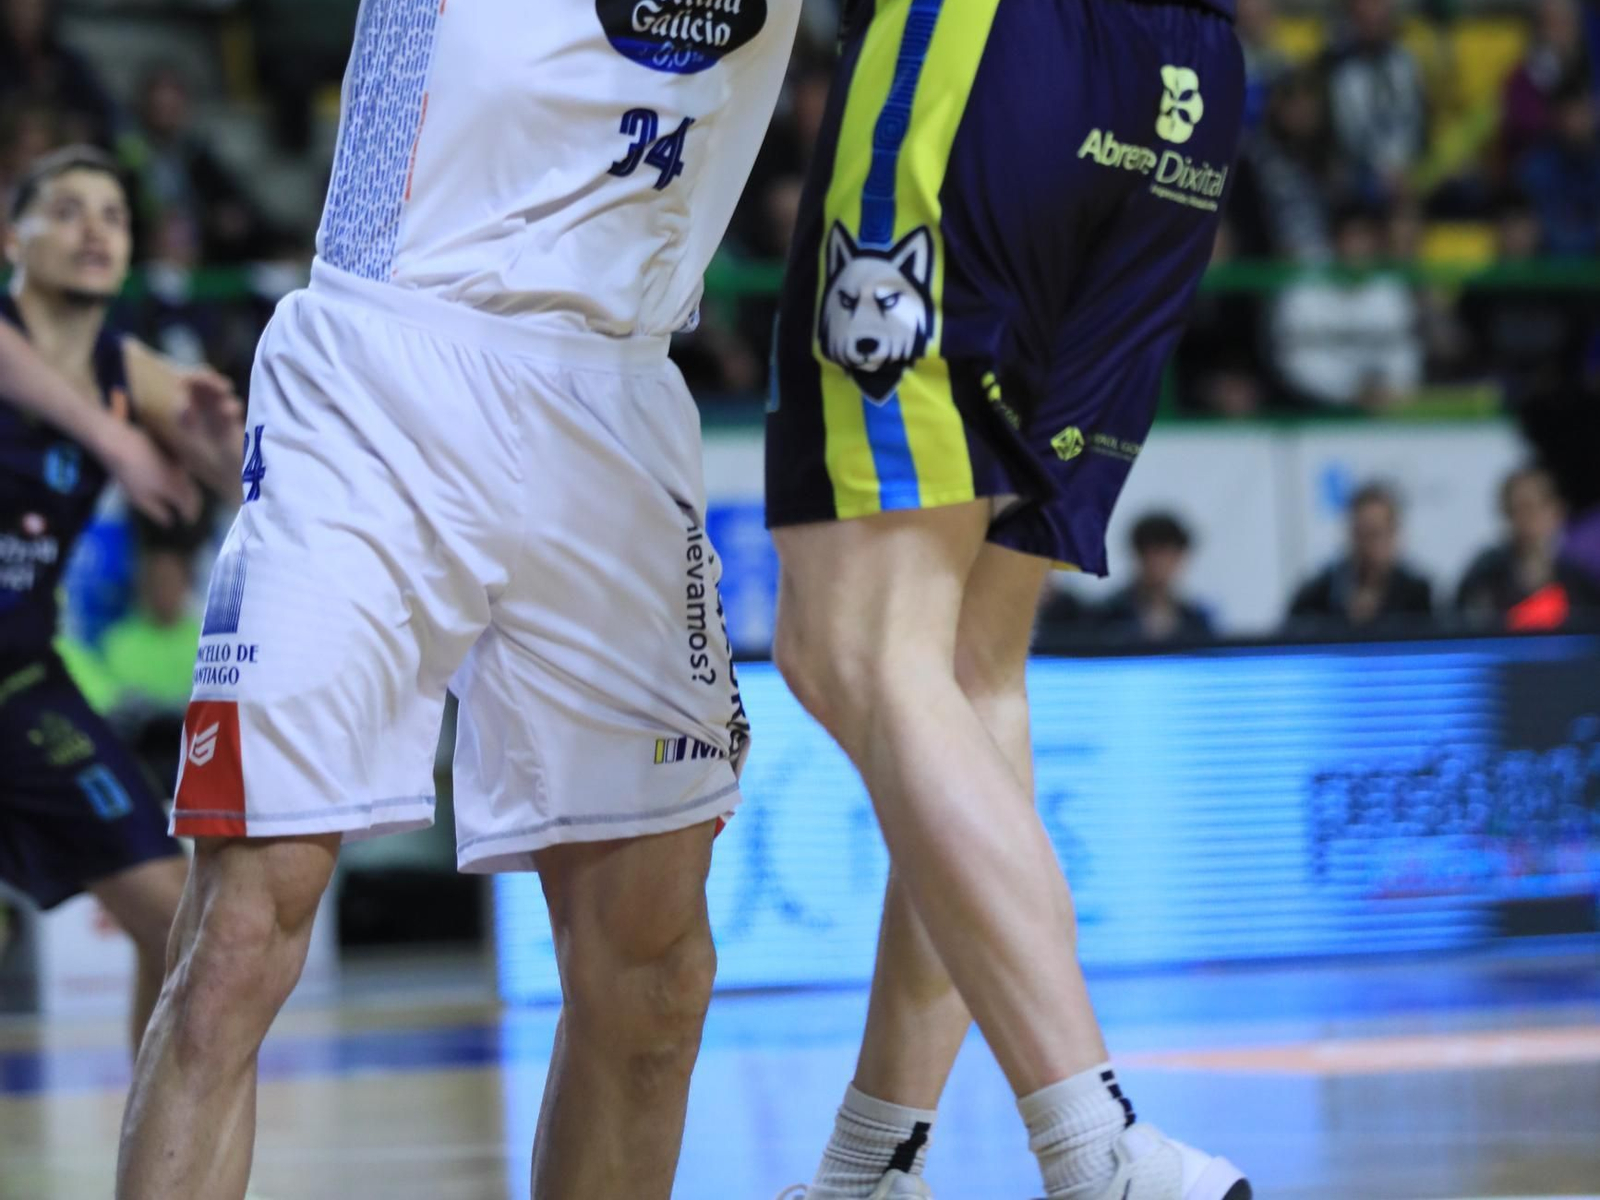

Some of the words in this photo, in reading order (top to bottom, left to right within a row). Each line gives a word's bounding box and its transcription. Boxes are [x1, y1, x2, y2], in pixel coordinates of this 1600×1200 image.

[606, 107, 696, 192] 34
[237, 643, 259, 663] DE
[193, 666, 240, 686] ANTIAGO
